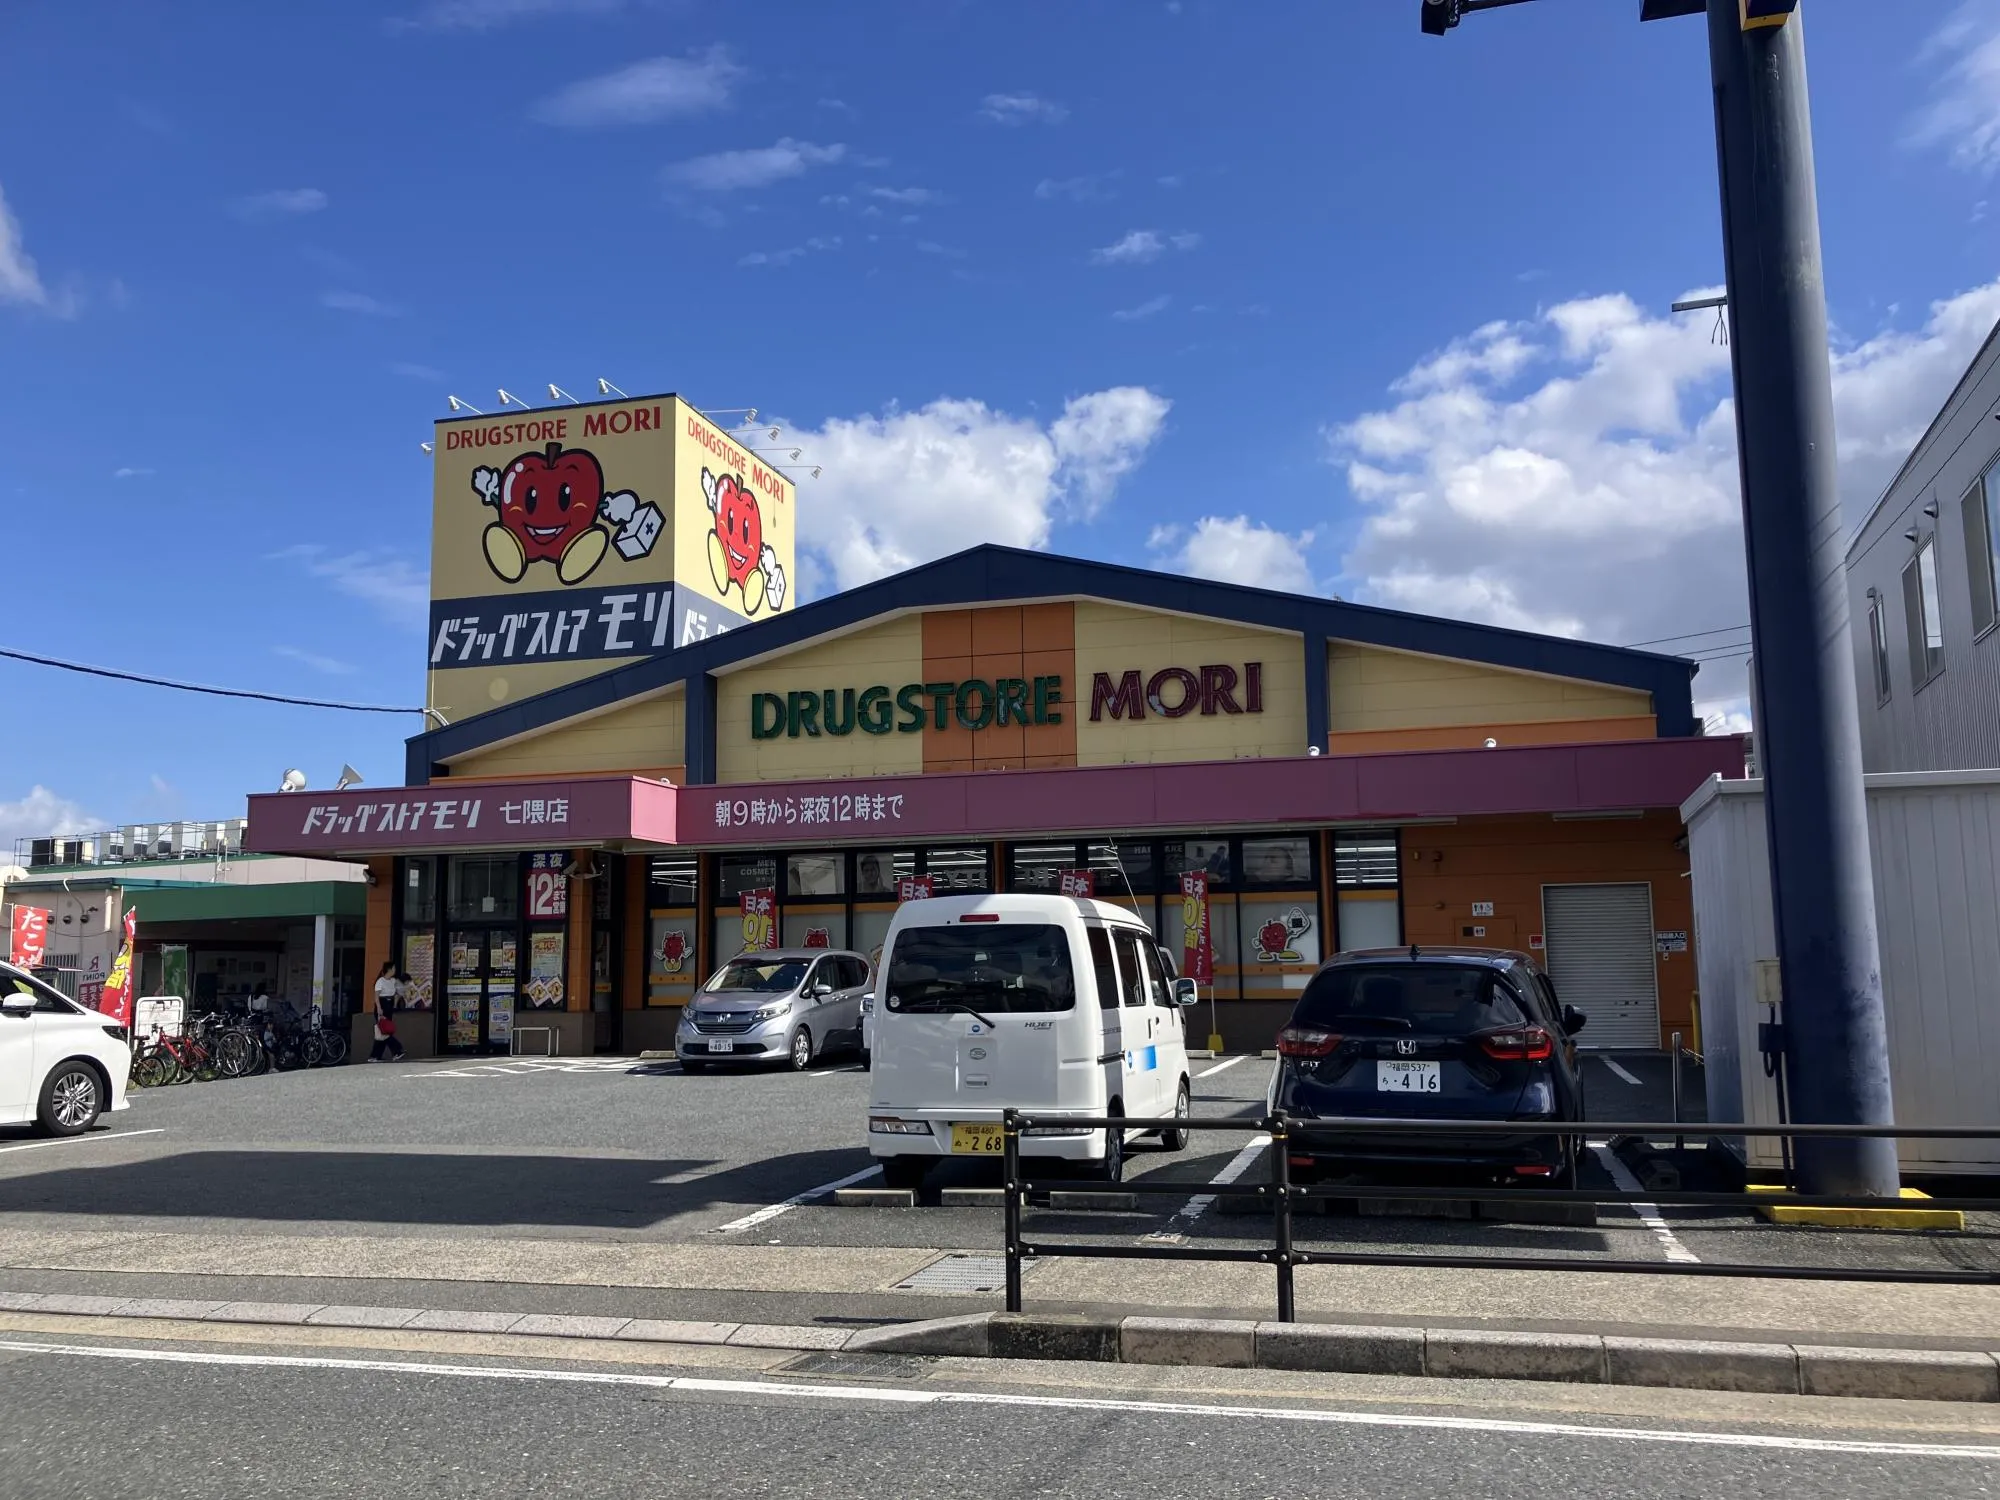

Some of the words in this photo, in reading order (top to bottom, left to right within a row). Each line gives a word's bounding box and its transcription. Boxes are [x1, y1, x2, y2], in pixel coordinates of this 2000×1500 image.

[446, 418, 567, 451] DRUGSTORE
[583, 406, 661, 437] MORI
[687, 415, 746, 475] DRUGSTORE
[752, 466, 784, 504] MORI
[751, 675, 1062, 740] DRUGSTORE
[1089, 662, 1264, 721] MORI
[499, 798, 569, 825] 七隈店
[715, 793, 904, 827] 朝9時から深夜12時まで
[532, 852, 563, 868] 深夜
[1024, 1021, 1055, 1030] HIJET
[1301, 1060, 1321, 1068] FIT
[1410, 1063, 1426, 1072] 537
